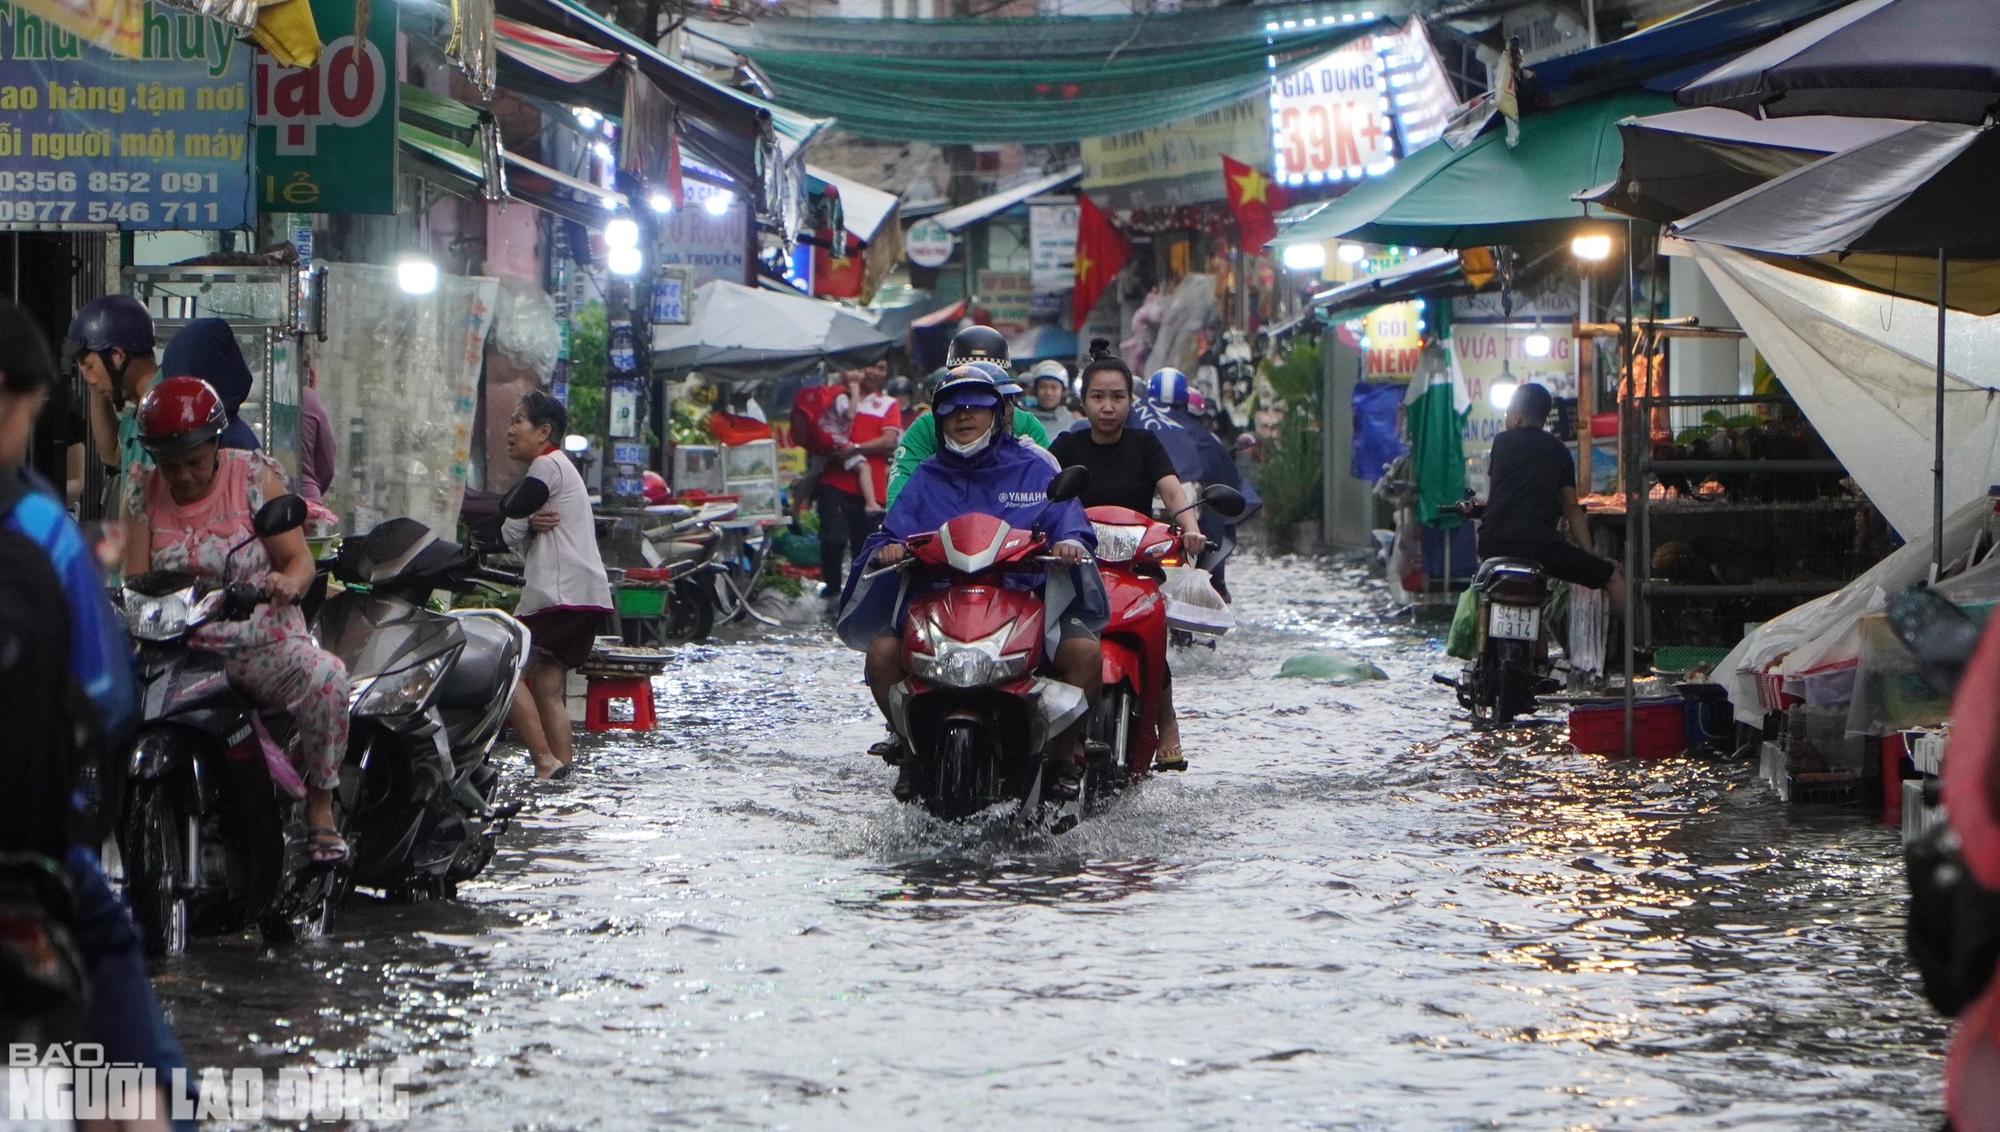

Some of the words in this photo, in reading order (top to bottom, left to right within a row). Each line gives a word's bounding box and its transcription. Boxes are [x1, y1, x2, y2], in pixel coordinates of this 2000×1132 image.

[49, 79, 126, 114] hàng
[136, 80, 185, 117] tận
[196, 82, 245, 111] nơi
[31, 127, 112, 161] người
[120, 127, 175, 163] một
[184, 127, 245, 161] máy
[1281, 101, 1384, 174] 39K+
[0, 171, 77, 193] 0356
[88, 171, 150, 193] 852
[161, 172, 218, 194] 091
[266, 171, 321, 204] lẻ
[0, 201, 77, 222] 0977
[88, 202, 150, 222] 546
[160, 202, 218, 223] 711
[1009, 491, 1047, 502] YAMAHA
[1497, 621, 1531, 637] 0314
[227, 723, 253, 748] YAMAHA
